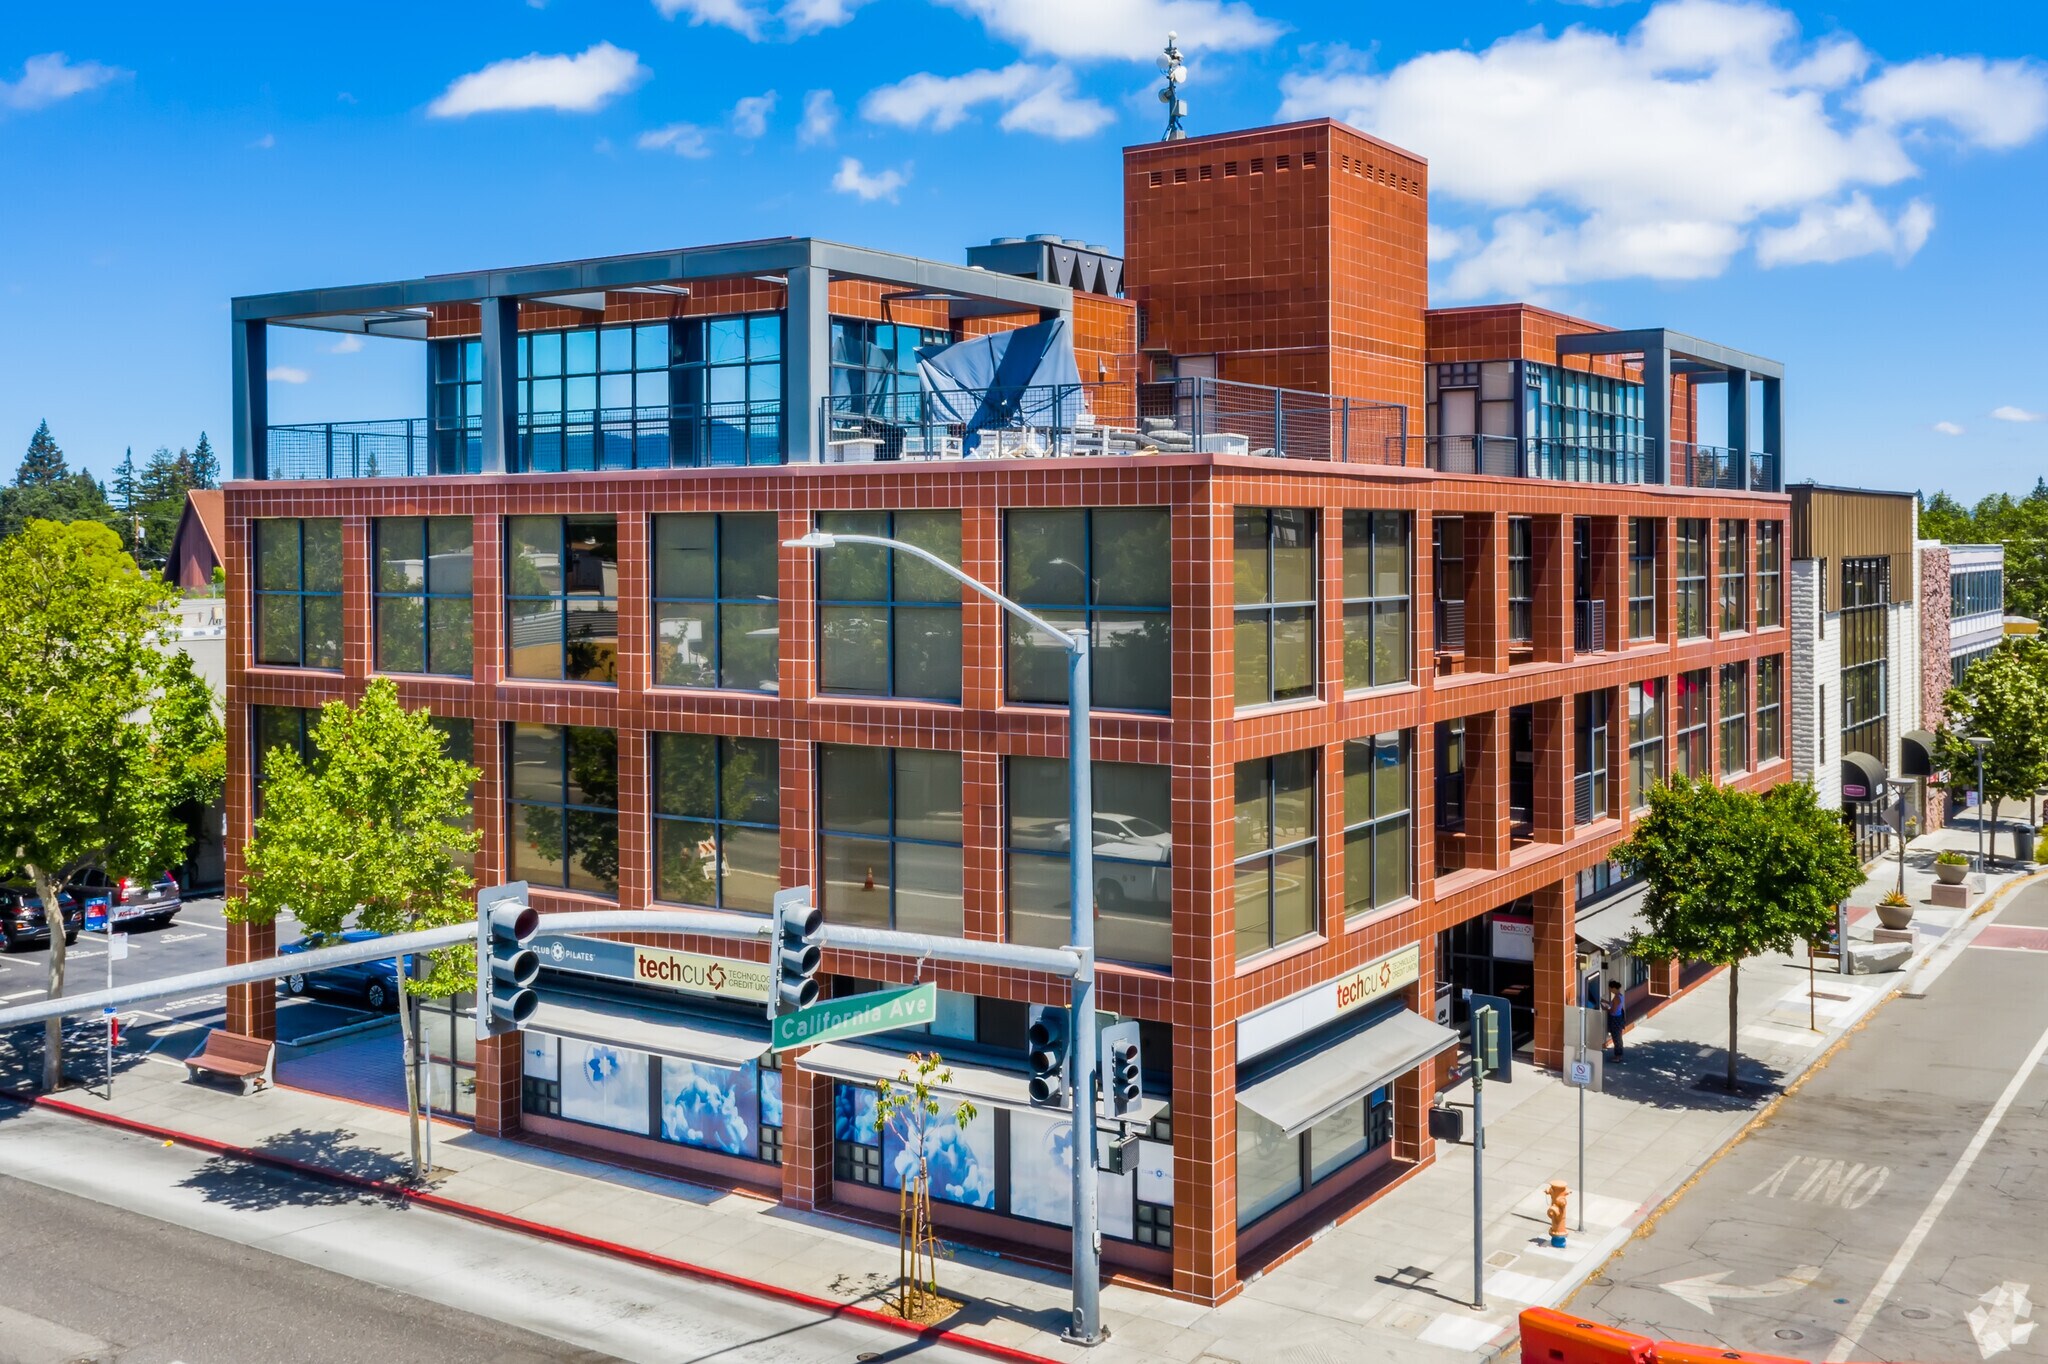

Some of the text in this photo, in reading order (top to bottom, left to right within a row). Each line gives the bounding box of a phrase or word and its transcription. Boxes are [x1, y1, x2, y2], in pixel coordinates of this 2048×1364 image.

[532, 945, 594, 962] CLUB PILATES
[728, 969, 771, 984] TECHNOLOG
[728, 979, 771, 992] CREDIT UNI
[781, 996, 928, 1040] California Ave
[1747, 1155, 1890, 1210] ONLY
